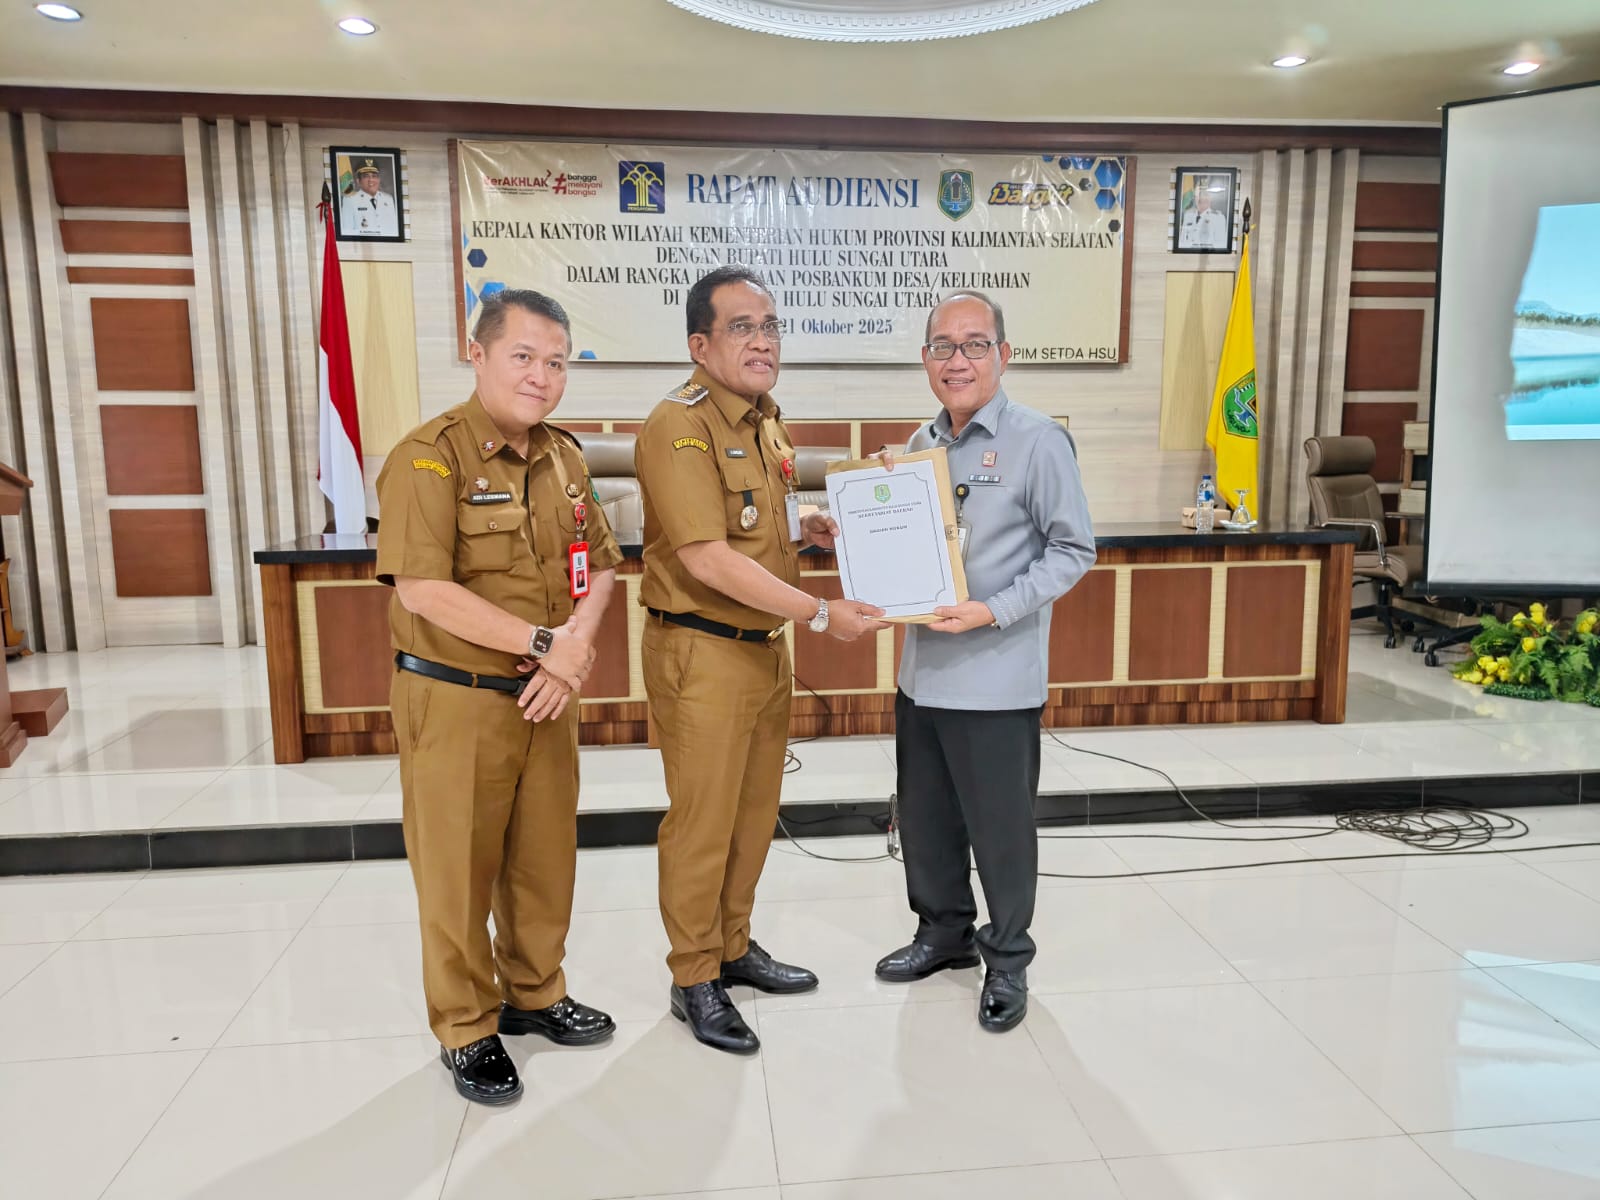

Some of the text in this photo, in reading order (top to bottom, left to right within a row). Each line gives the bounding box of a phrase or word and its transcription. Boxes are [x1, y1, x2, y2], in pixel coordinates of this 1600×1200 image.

[686, 173, 920, 208] RAPAT AUDIENSI
[472, 220, 1115, 249] KEPALA KANTOR WILAYAH KEMENTERIAN HUKUM PROVINSI KALIMANTAN SELATAN
[657, 246, 949, 268] DENGAN BUPATI HULU SUNGAI UTARA
[567, 265, 619, 283] DALAM
[626, 267, 690, 285] RANGKA
[792, 270, 887, 288] POSBANKUM
[893, 271, 1031, 291] DESA/KELURAHAN
[663, 288, 680, 306] DI
[783, 291, 827, 307] HULU
[832, 291, 889, 308] SUNGAI
[894, 292, 941, 308] UTARA
[801, 318, 854, 335] Oktober
[858, 318, 893, 335] 2025
[1009, 347, 1116, 360] PIM SETDA HSU
